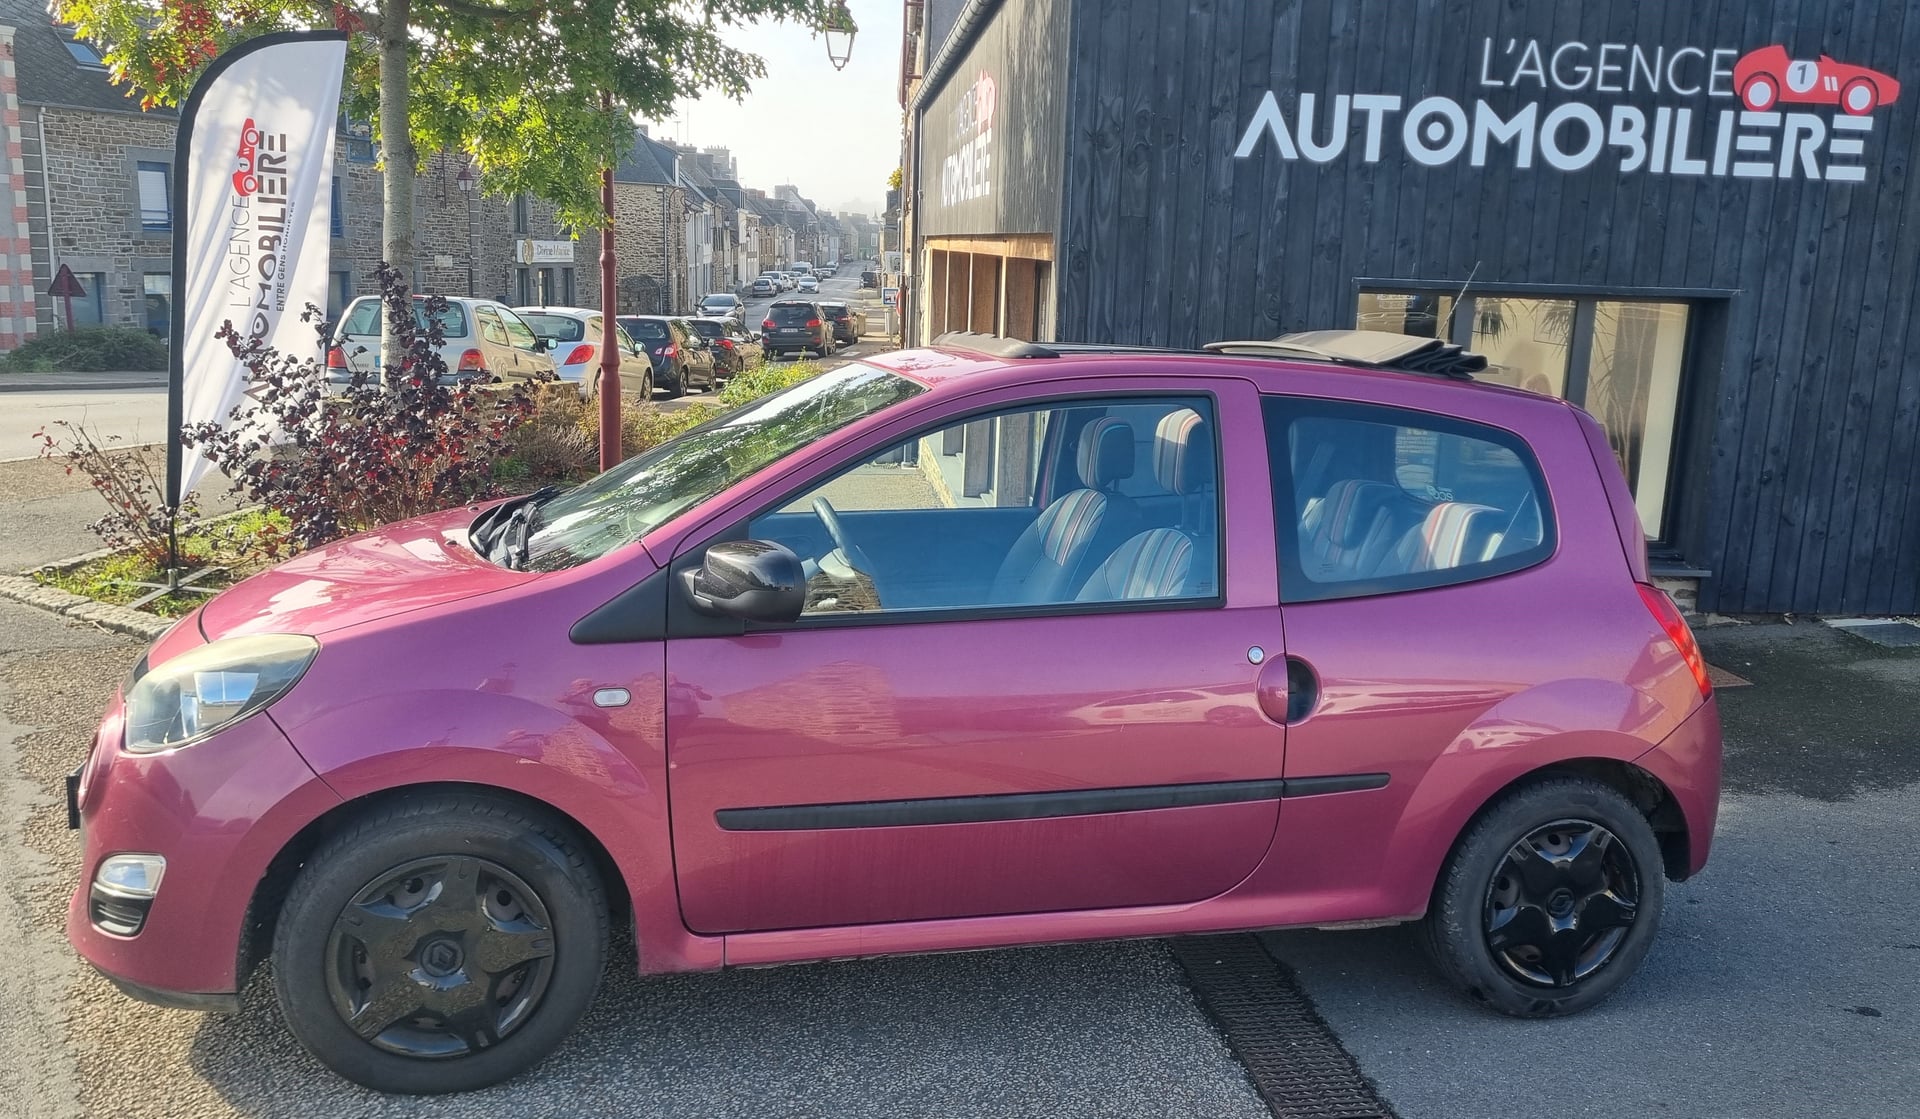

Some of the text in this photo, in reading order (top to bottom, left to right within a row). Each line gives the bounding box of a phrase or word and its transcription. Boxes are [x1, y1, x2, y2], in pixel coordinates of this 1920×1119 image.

[1480, 36, 1738, 97] L'AGENCE
[1797, 63, 1808, 85] 1
[1233, 89, 1874, 182] AUTOMOBILIERE
[229, 194, 251, 307] L'AGENCE
[277, 254, 287, 280] GENS
[276, 282, 286, 312] ENTRE
